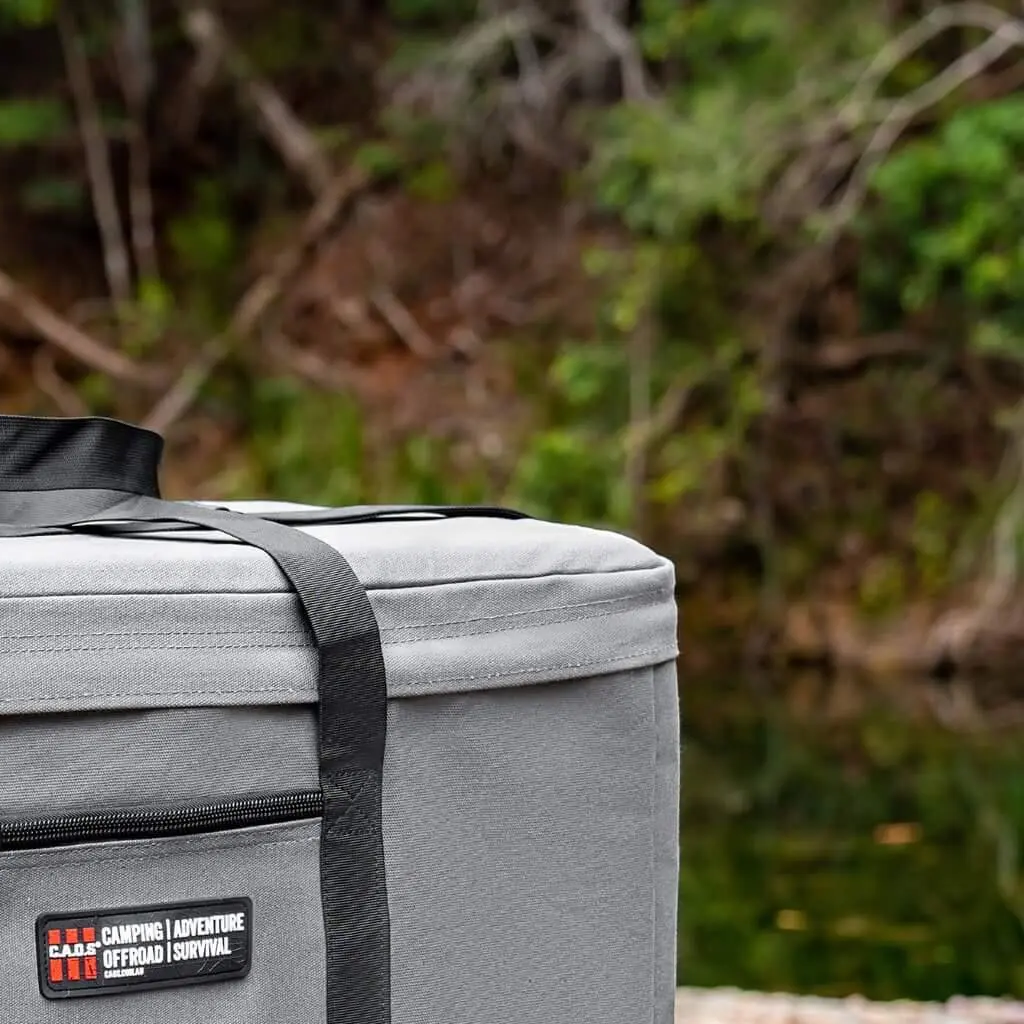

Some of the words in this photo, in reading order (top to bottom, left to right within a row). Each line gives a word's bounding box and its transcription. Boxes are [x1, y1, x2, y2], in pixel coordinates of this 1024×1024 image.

[101, 920, 164, 946] CAMPING
[173, 912, 245, 938] ADVENTURE
[103, 943, 164, 968] OFFROAD
[173, 936, 232, 963] SURVIVAL
